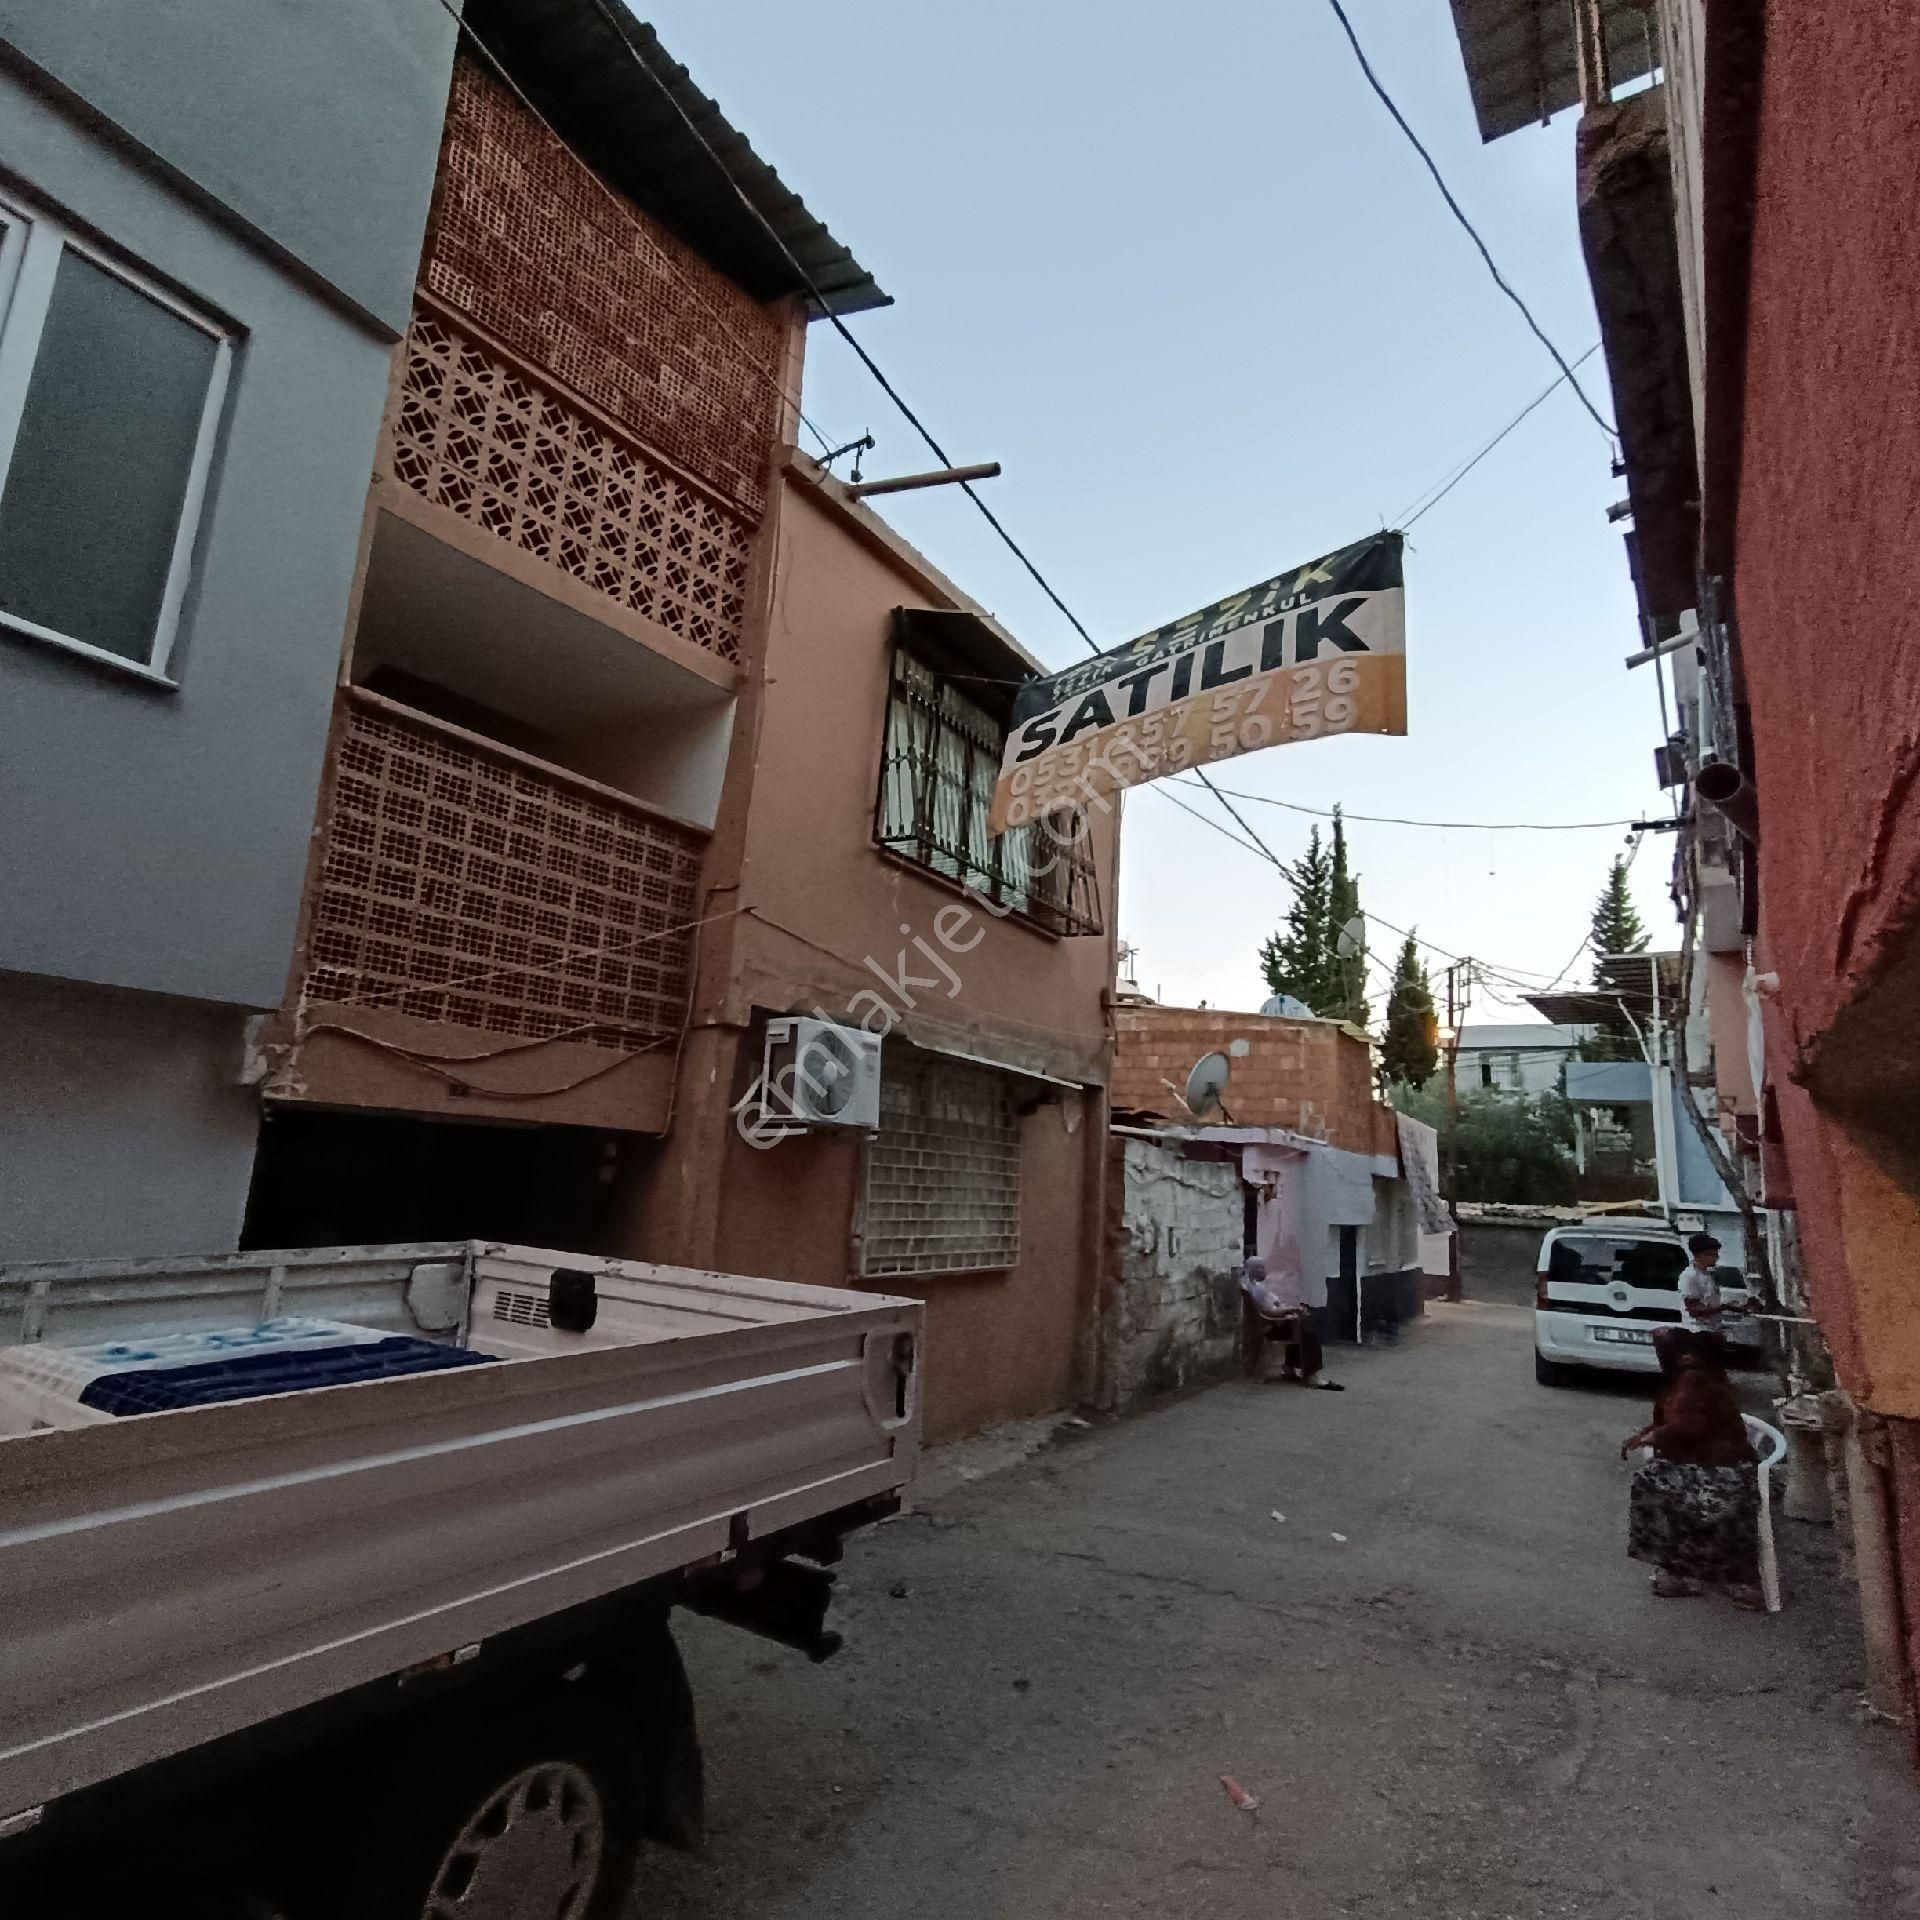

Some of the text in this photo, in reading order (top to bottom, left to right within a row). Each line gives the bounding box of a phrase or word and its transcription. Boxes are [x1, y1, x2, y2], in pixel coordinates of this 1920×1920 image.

[1009, 737, 1099, 796] 0531
[1209, 676, 1273, 724] 57
[1289, 659, 1361, 704] 26
[1016, 597, 1370, 763] SATILIK
[1208, 714, 1273, 760] 50
[1289, 696, 1359, 740] 59
